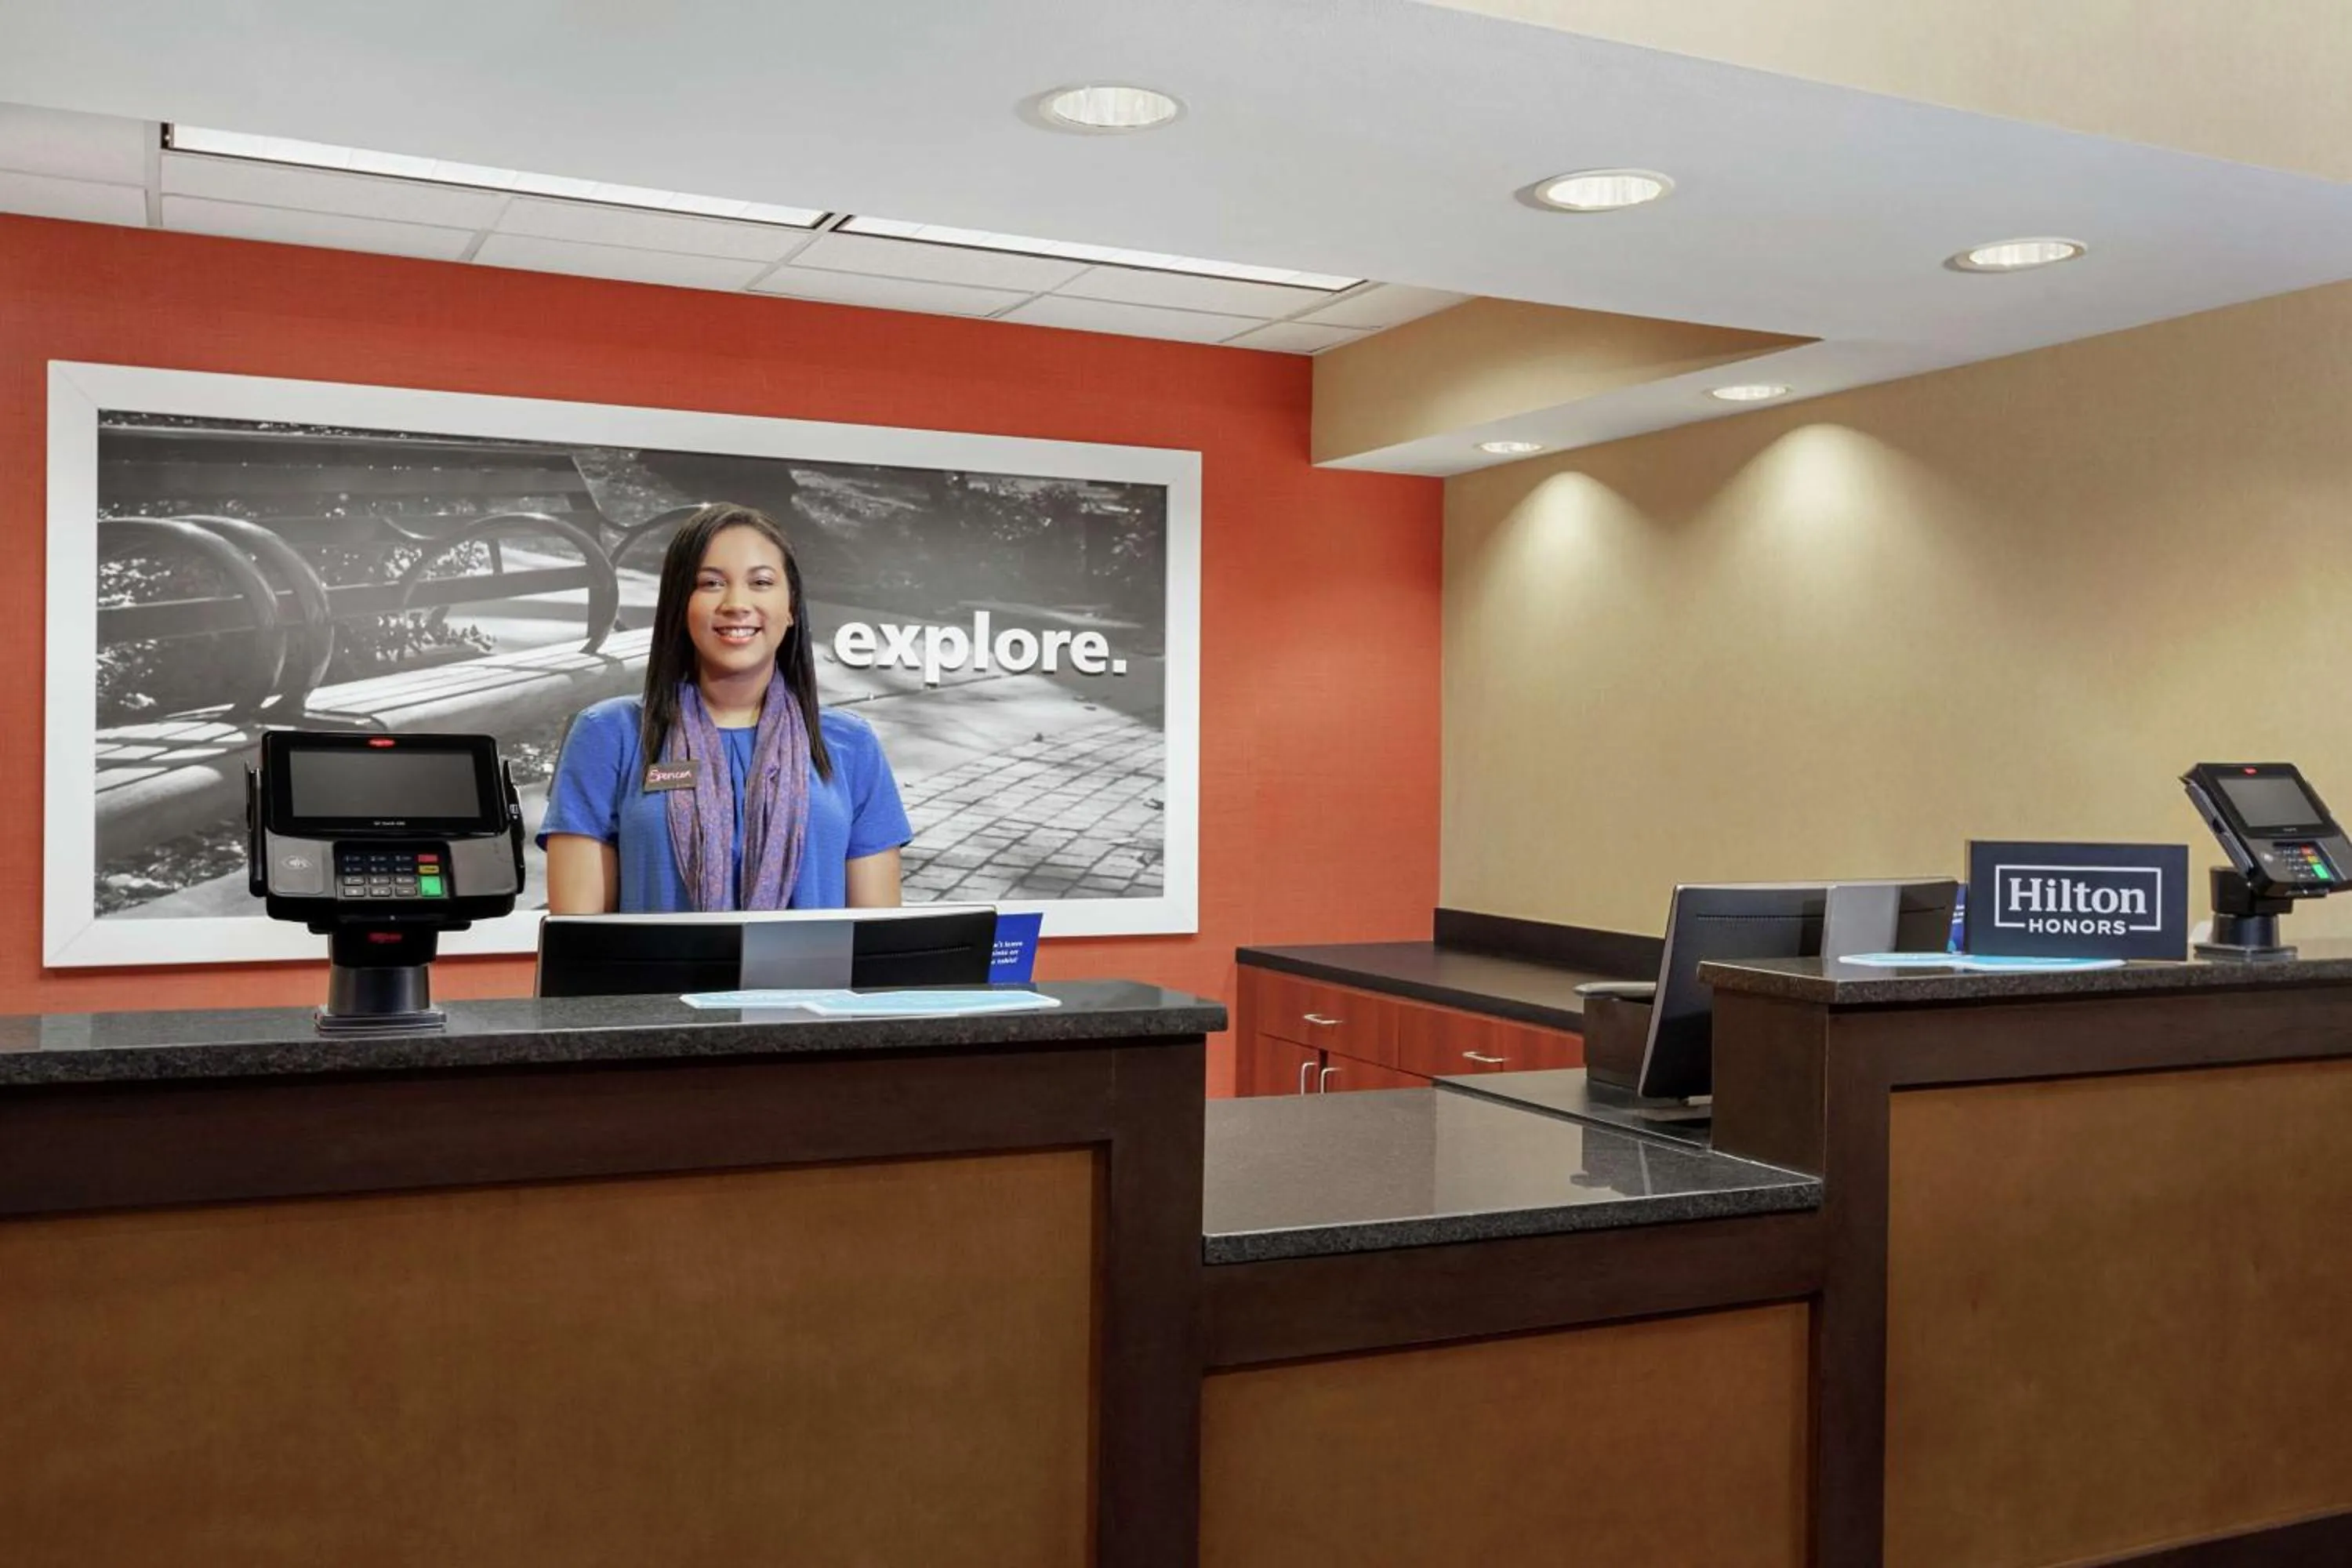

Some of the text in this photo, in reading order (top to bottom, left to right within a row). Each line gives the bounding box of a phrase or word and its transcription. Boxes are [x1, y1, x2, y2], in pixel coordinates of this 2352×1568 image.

[833, 611, 1127, 687] explore.
[2008, 877, 2147, 914] Hilton
[2028, 919, 2127, 935] HONORS
